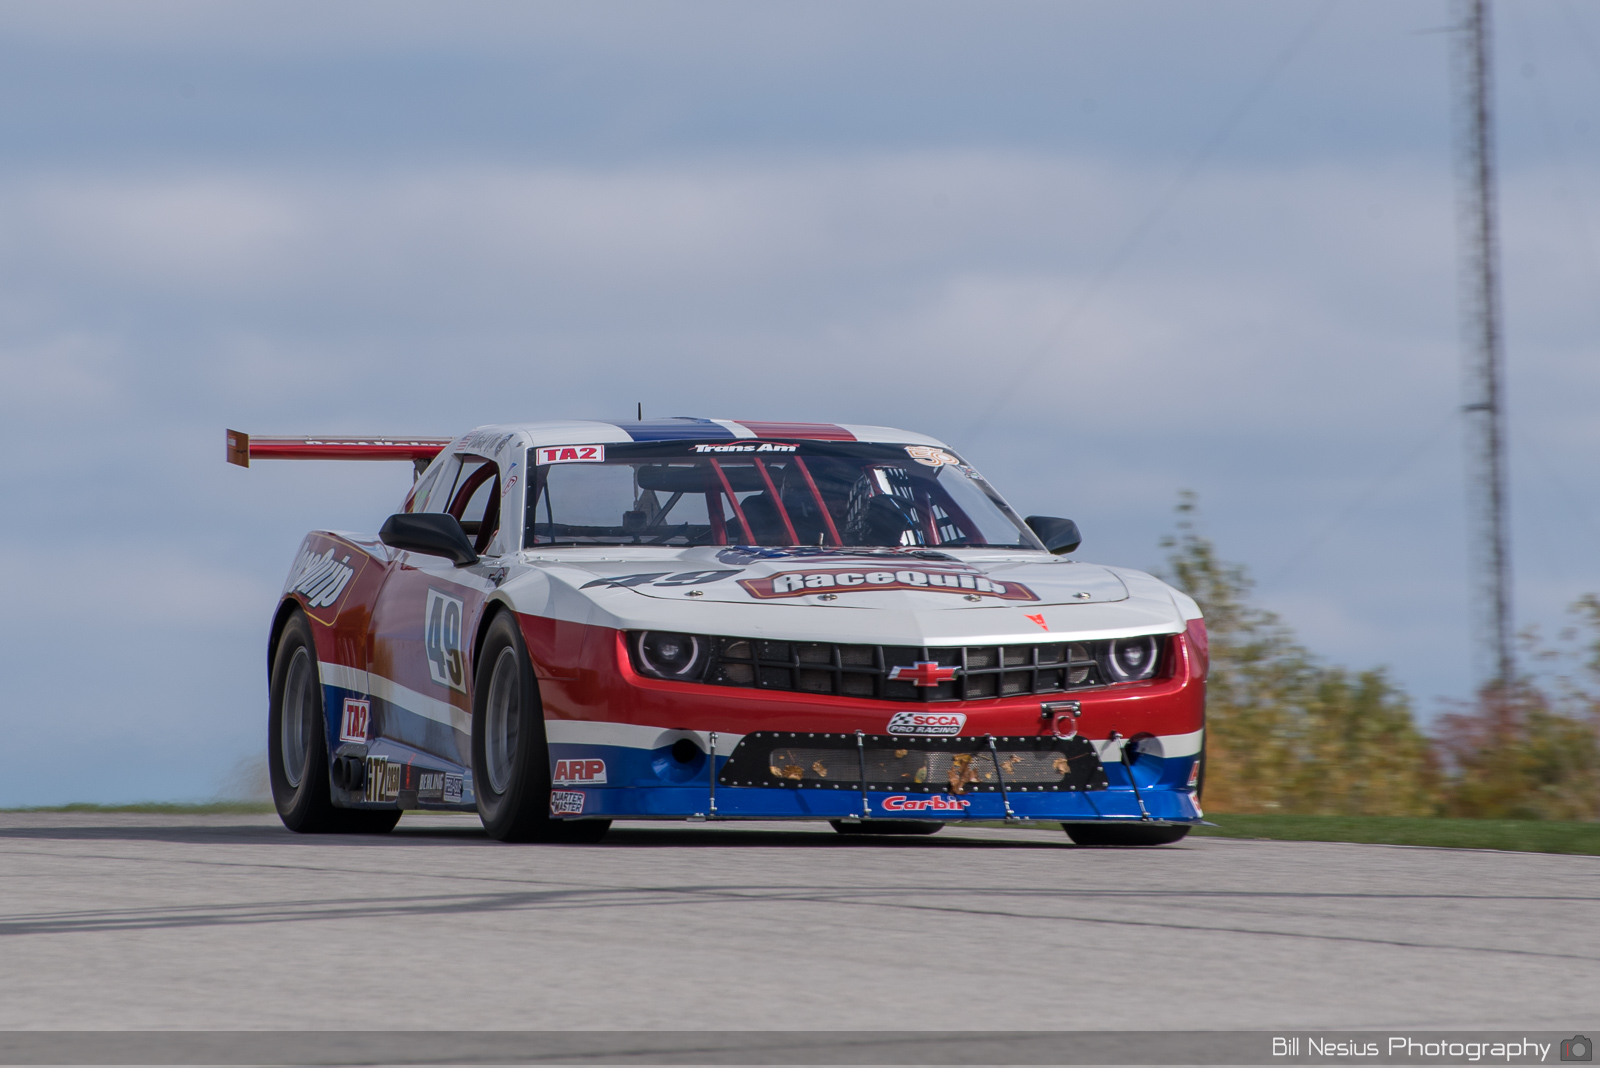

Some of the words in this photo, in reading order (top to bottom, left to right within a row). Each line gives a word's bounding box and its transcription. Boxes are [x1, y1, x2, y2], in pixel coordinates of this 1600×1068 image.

[543, 448, 597, 461] TA2
[695, 444, 756, 452] Trans
[756, 443, 796, 452] Am
[773, 570, 1006, 594] RaceQuip
[427, 595, 462, 687] 49
[346, 704, 367, 738] TA2
[913, 716, 960, 726] SCCA
[890, 725, 915, 733] PRO
[915, 726, 959, 734] RACING
[554, 761, 605, 780] ARP
[882, 796, 971, 811] Carbir
